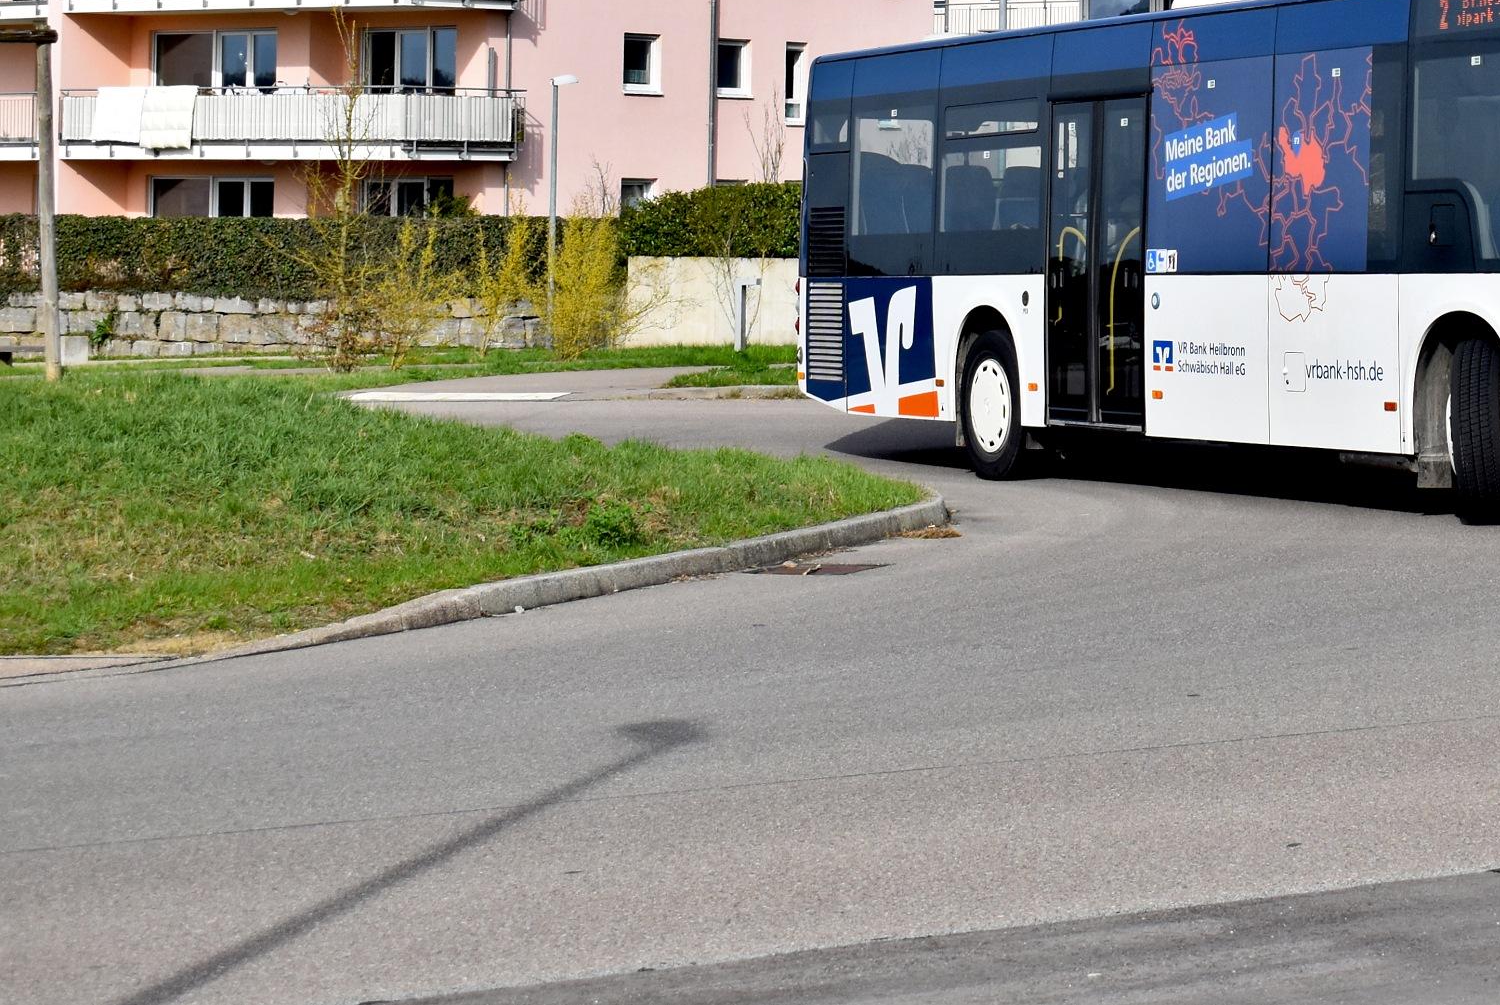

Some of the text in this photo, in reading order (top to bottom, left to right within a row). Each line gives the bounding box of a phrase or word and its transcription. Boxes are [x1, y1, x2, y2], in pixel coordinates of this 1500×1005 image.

[1165, 119, 1236, 162] Meine Bank
[1166, 152, 1251, 192] der Regionen.
[1177, 341, 1246, 356] VR Bank Heilbronn
[1177, 359, 1246, 376] Schwäbisch Hall eG
[1306, 359, 1384, 381] vrbank-hsh.de
